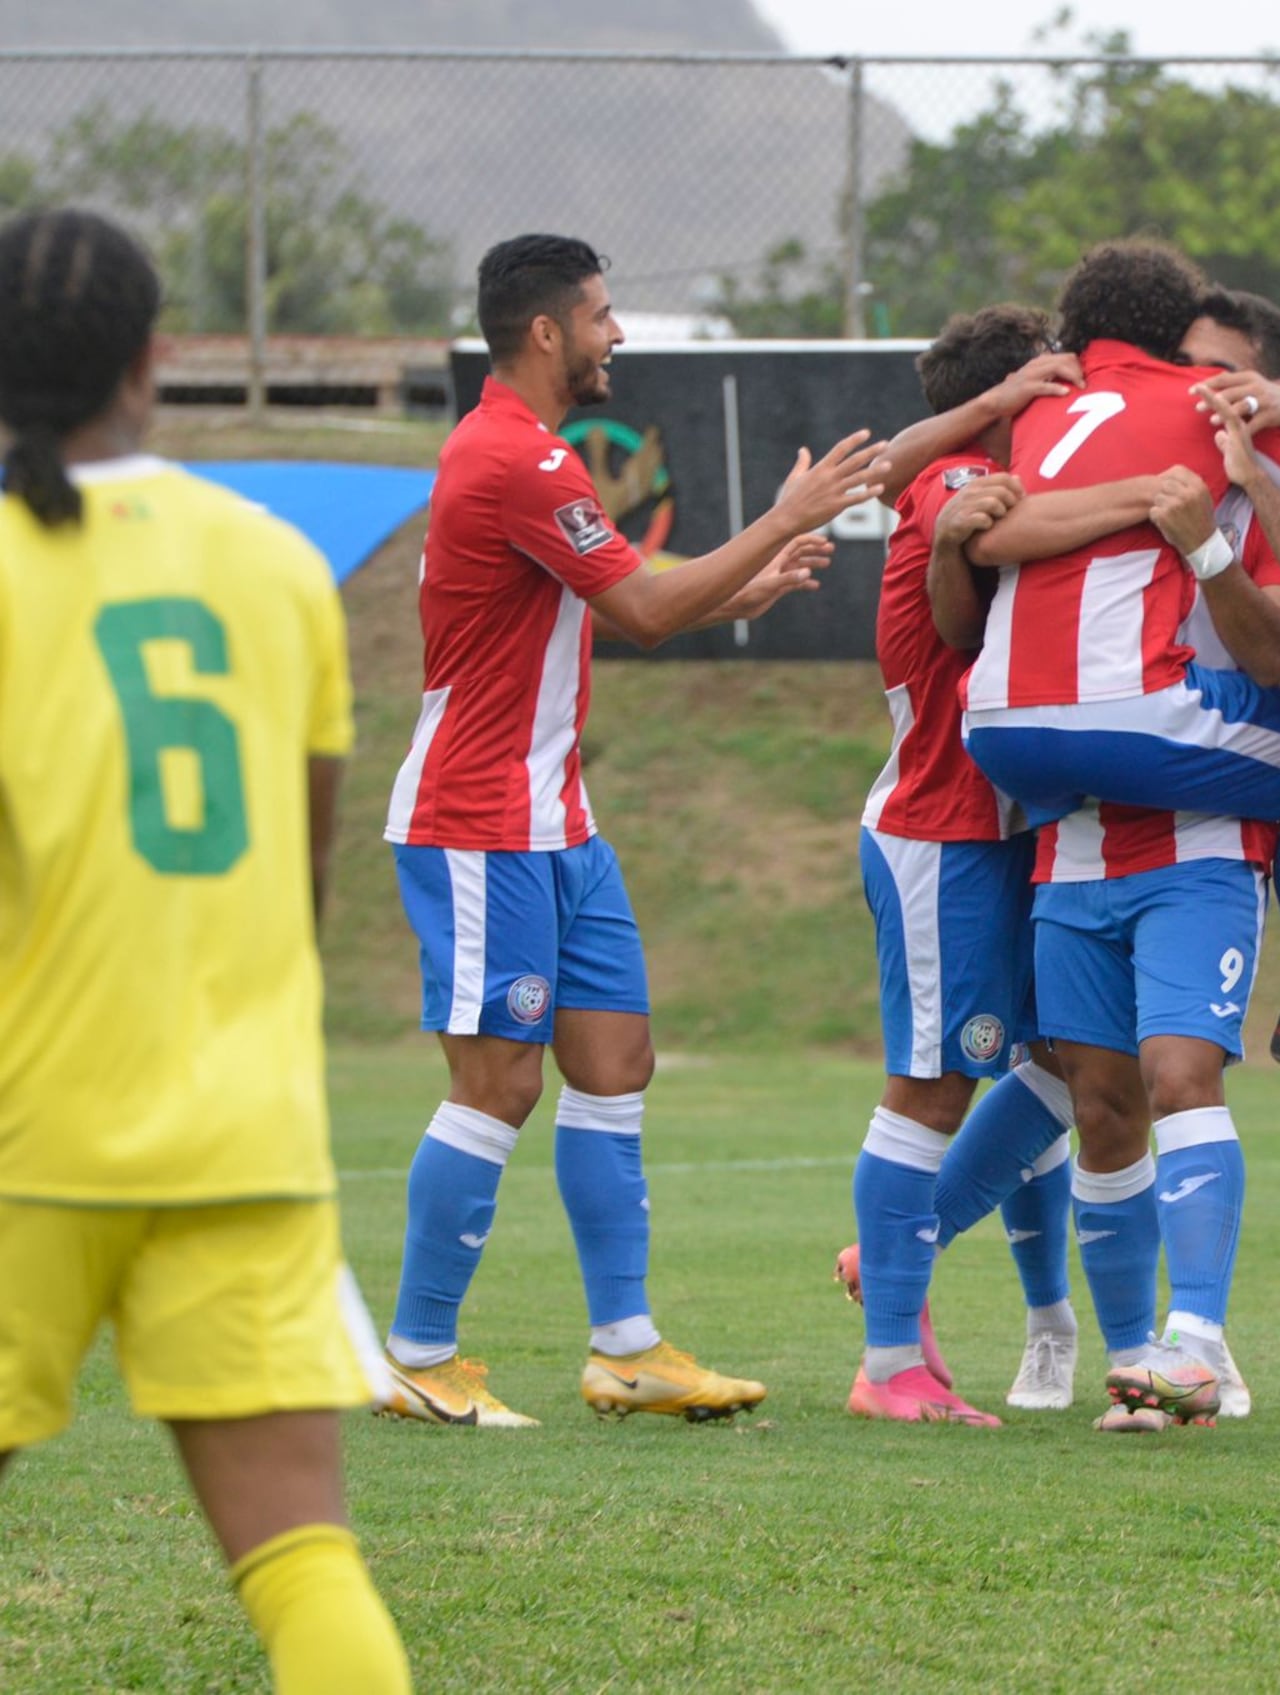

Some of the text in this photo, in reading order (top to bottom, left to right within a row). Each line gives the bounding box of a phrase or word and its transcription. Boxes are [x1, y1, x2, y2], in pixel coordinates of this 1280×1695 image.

[1039, 391, 1126, 479] 7
[93, 595, 252, 876] 6
[1219, 947, 1244, 994] 9
